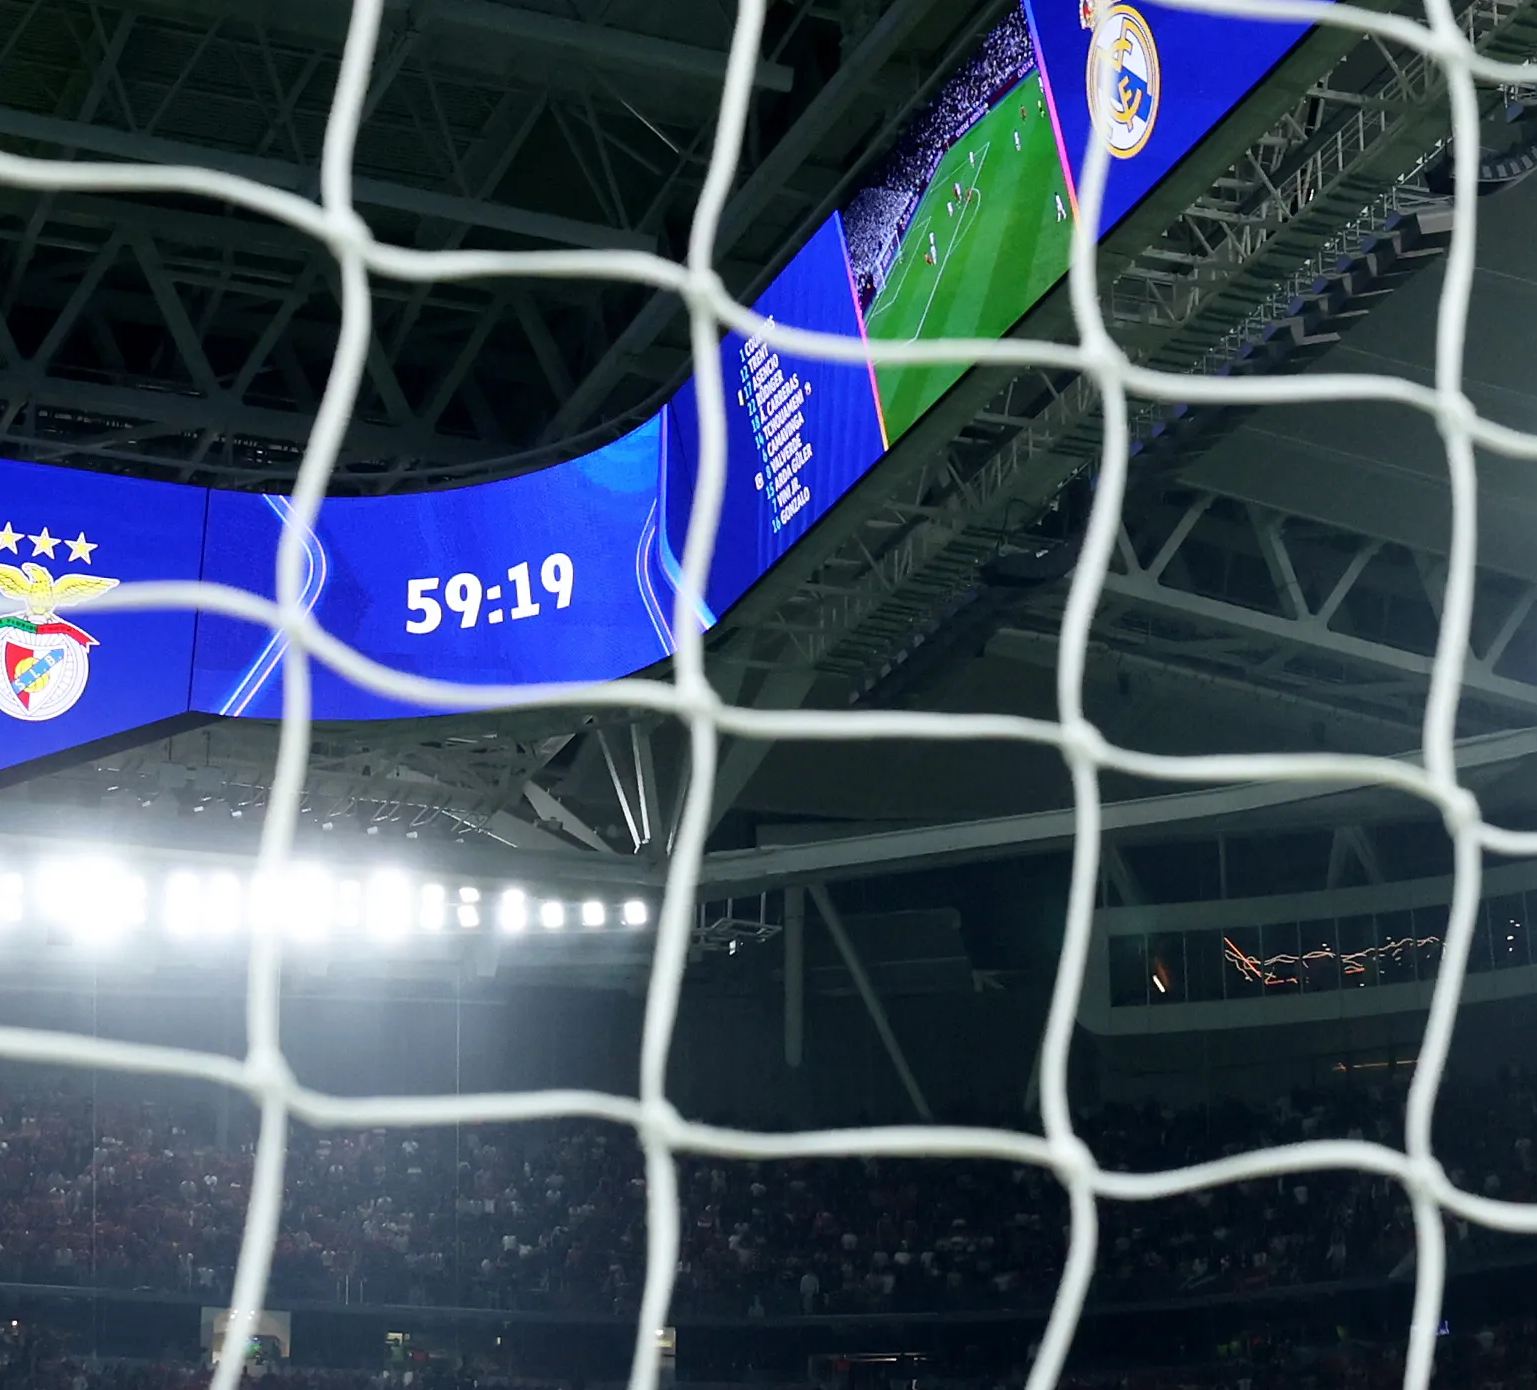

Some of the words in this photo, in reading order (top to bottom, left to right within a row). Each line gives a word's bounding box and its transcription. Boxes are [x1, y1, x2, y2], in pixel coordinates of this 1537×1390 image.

[744, 315, 776, 357] COUS
[752, 353, 779, 391] ASENCIO
[774, 464, 793, 492] ARDA
[780, 486, 811, 525] GONZALO
[405, 552, 574, 635] 59:19
